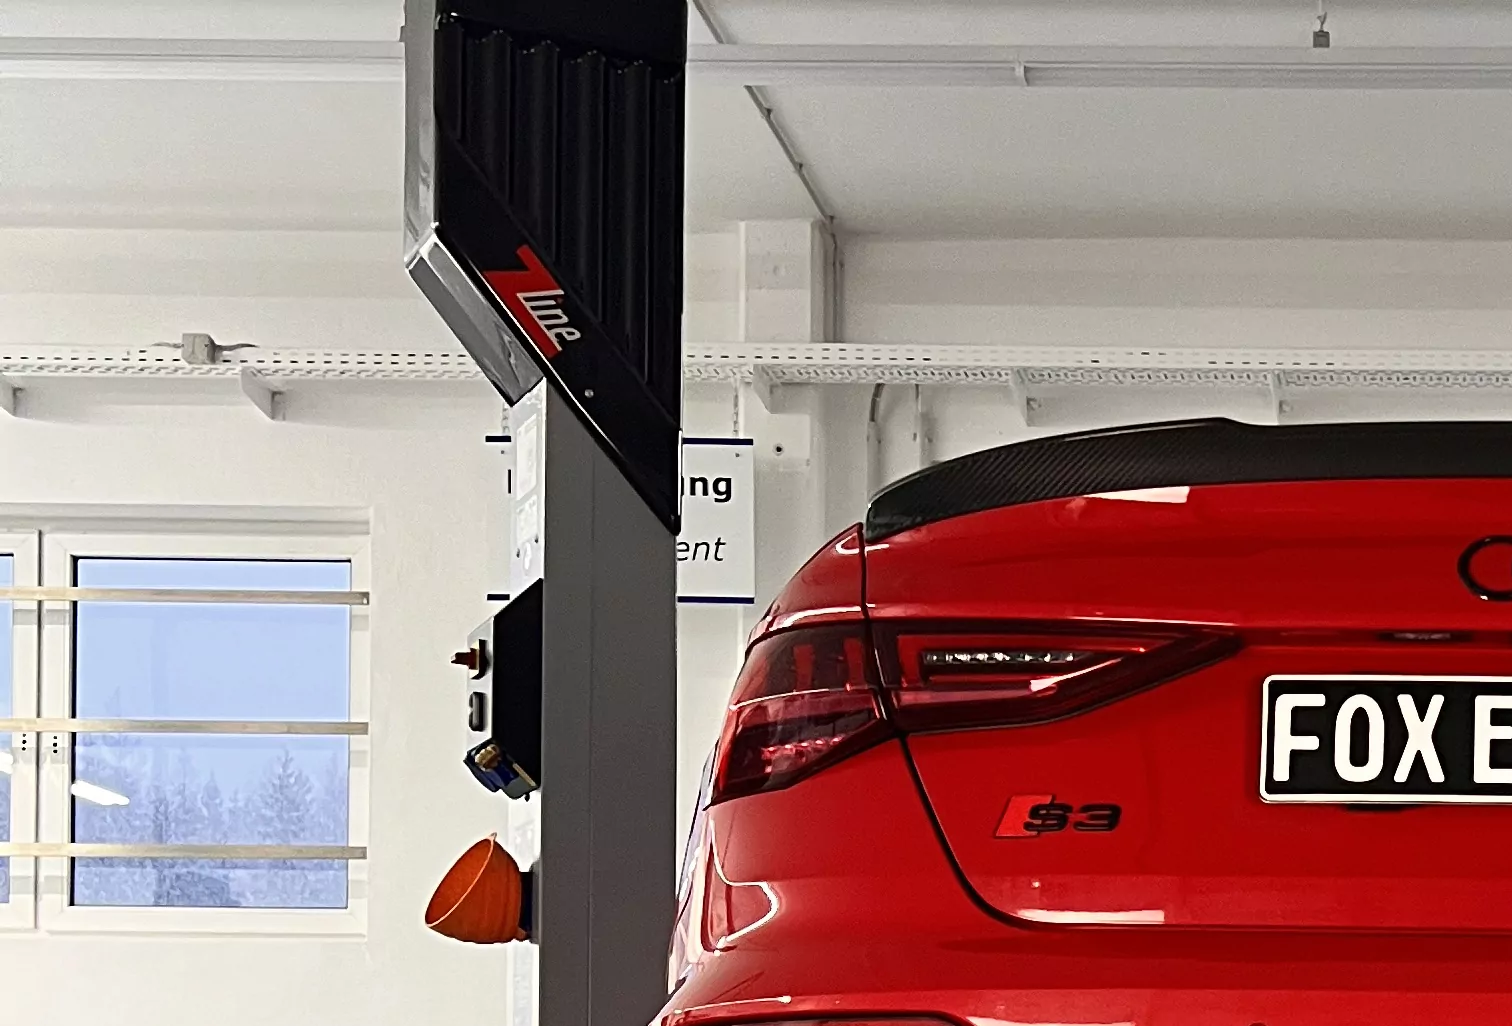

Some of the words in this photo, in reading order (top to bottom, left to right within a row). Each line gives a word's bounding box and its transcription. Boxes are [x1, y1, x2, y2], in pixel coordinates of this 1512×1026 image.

[681, 476, 732, 503] ng
[1273, 694, 1445, 783] FOX
[1023, 803, 1122, 832] S3
